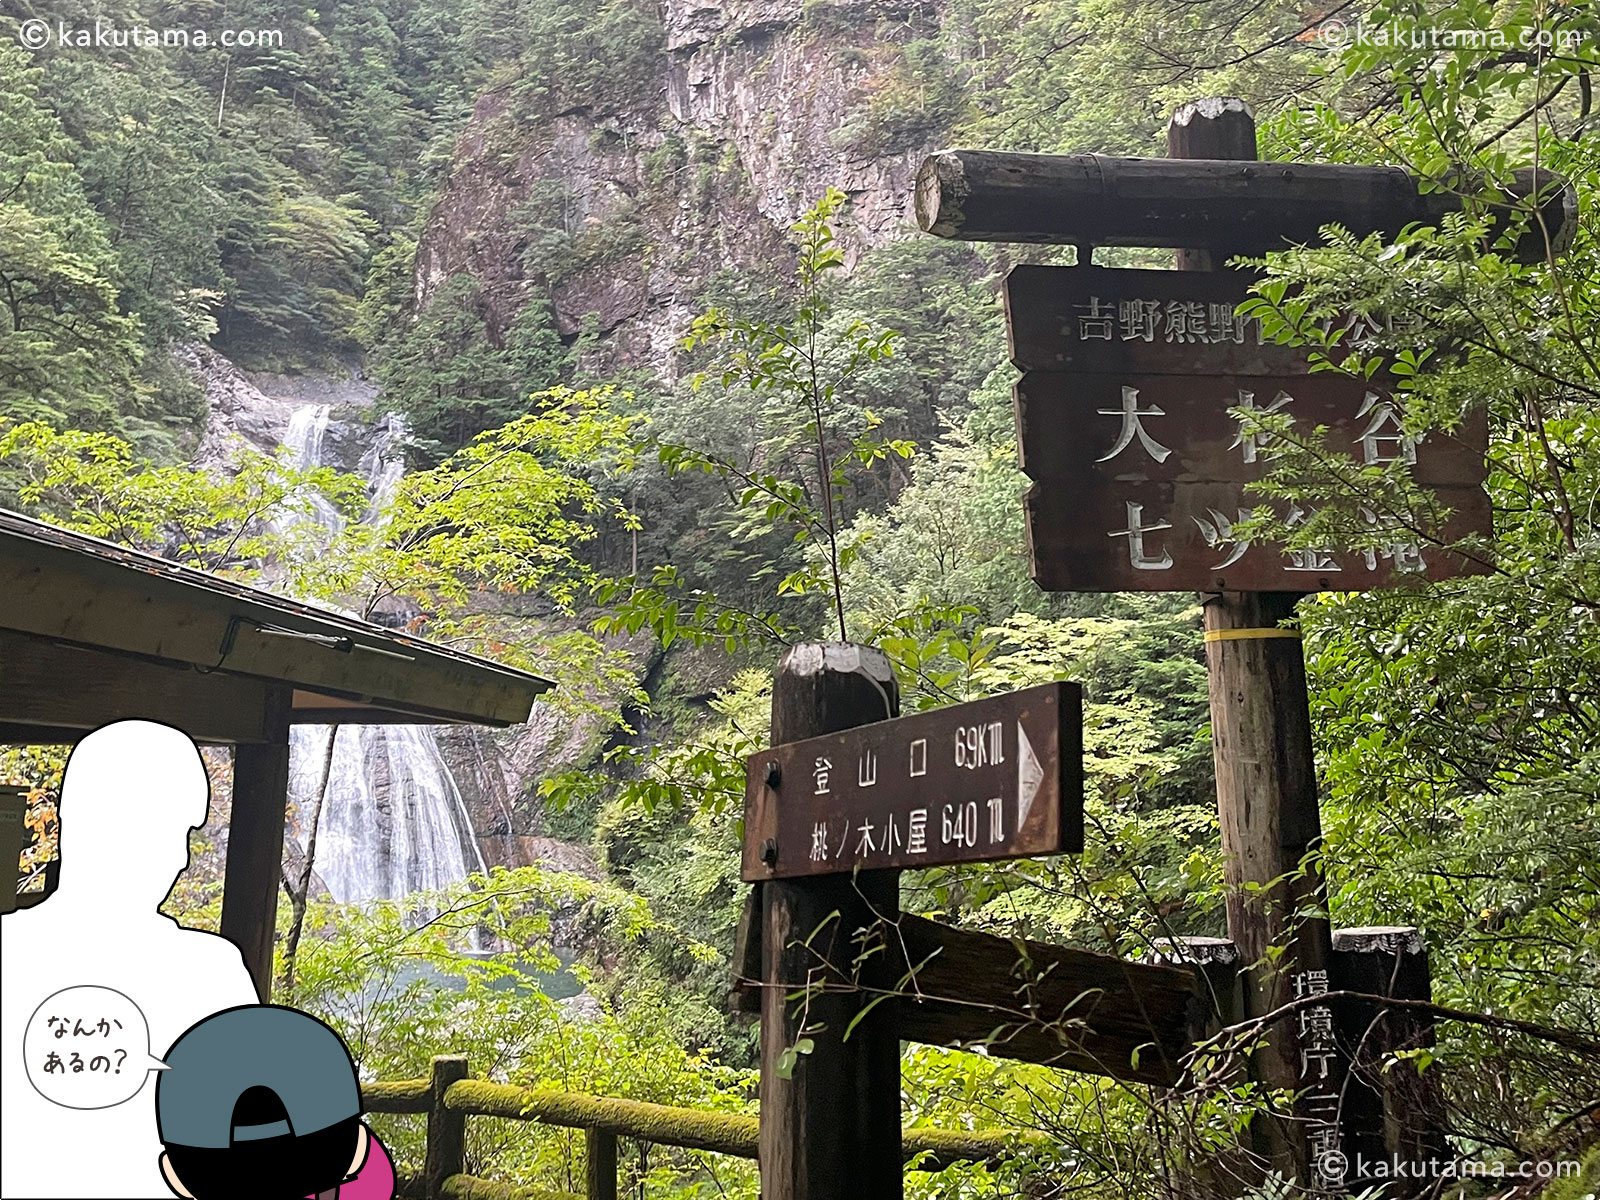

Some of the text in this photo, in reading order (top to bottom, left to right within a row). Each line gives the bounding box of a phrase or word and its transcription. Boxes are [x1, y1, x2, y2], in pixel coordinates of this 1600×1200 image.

[812, 738, 927, 796] 登山口
[809, 808, 927, 862] 桃ノ木小屋
